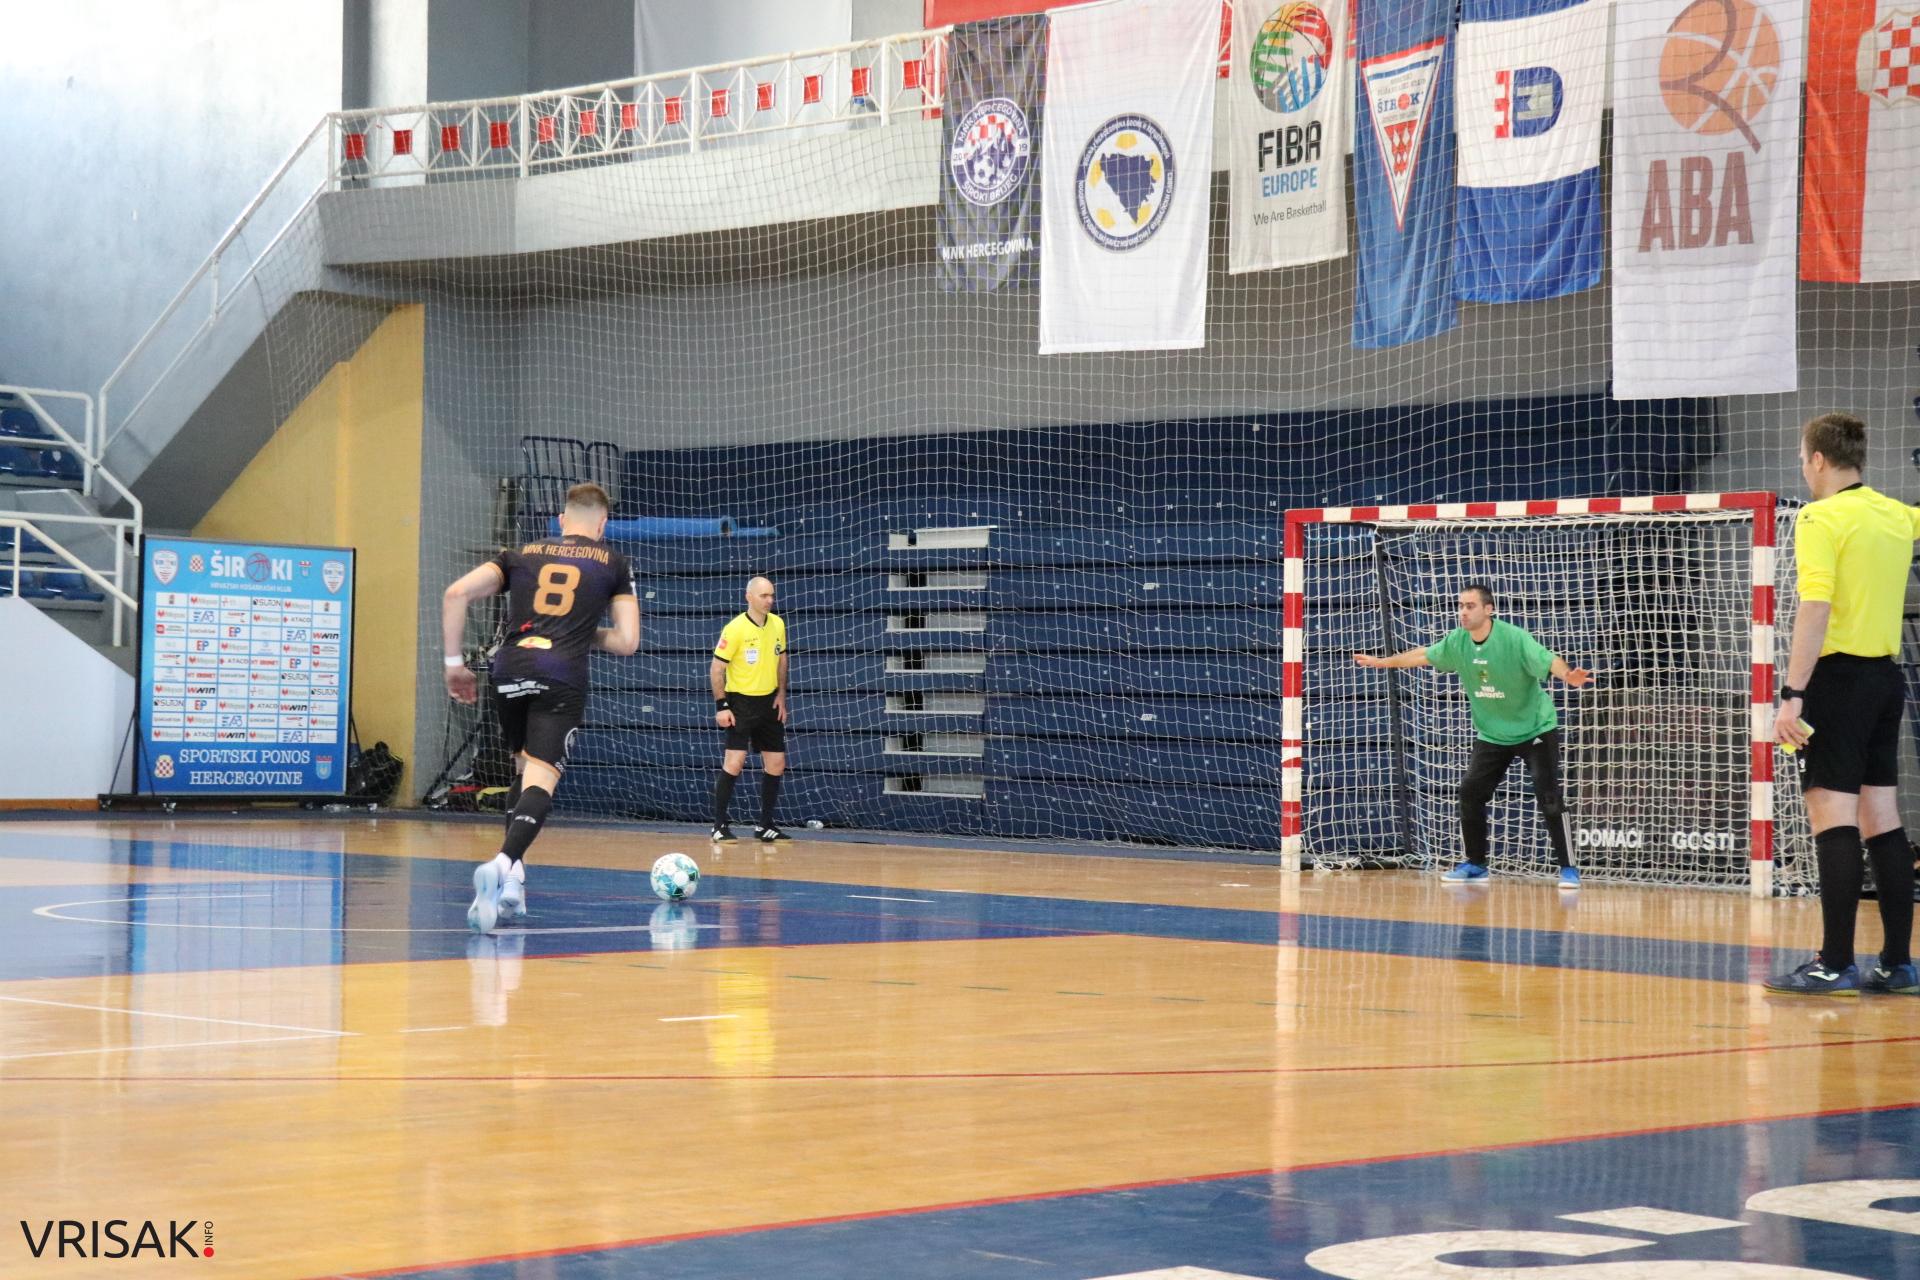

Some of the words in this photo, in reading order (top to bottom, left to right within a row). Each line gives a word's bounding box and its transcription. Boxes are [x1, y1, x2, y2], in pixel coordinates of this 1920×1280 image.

[1259, 120, 1322, 172] FIBA
[1262, 167, 1318, 198] EUROPE
[1638, 151, 1753, 253] ABA
[1253, 212, 1268, 226] We
[1270, 210, 1285, 223] Are
[1286, 200, 1327, 220] Basketball
[942, 246, 964, 260] MNK
[966, 237, 1034, 258] HERCEGOVINA
[545, 544, 610, 565] HERCEGOVINA
[533, 563, 581, 617] 8
[229, 626, 241, 638] EP
[196, 640, 209, 651] EP
[290, 658, 301, 669] EP
[194, 700, 207, 711] EP
[179, 749, 257, 764] SPORTSKI
[260, 750, 311, 765] PONOS
[189, 771, 303, 785] HERCEGOVINE
[1578, 828, 1642, 849] DOMAĆI
[1671, 831, 1735, 851] GOSTI
